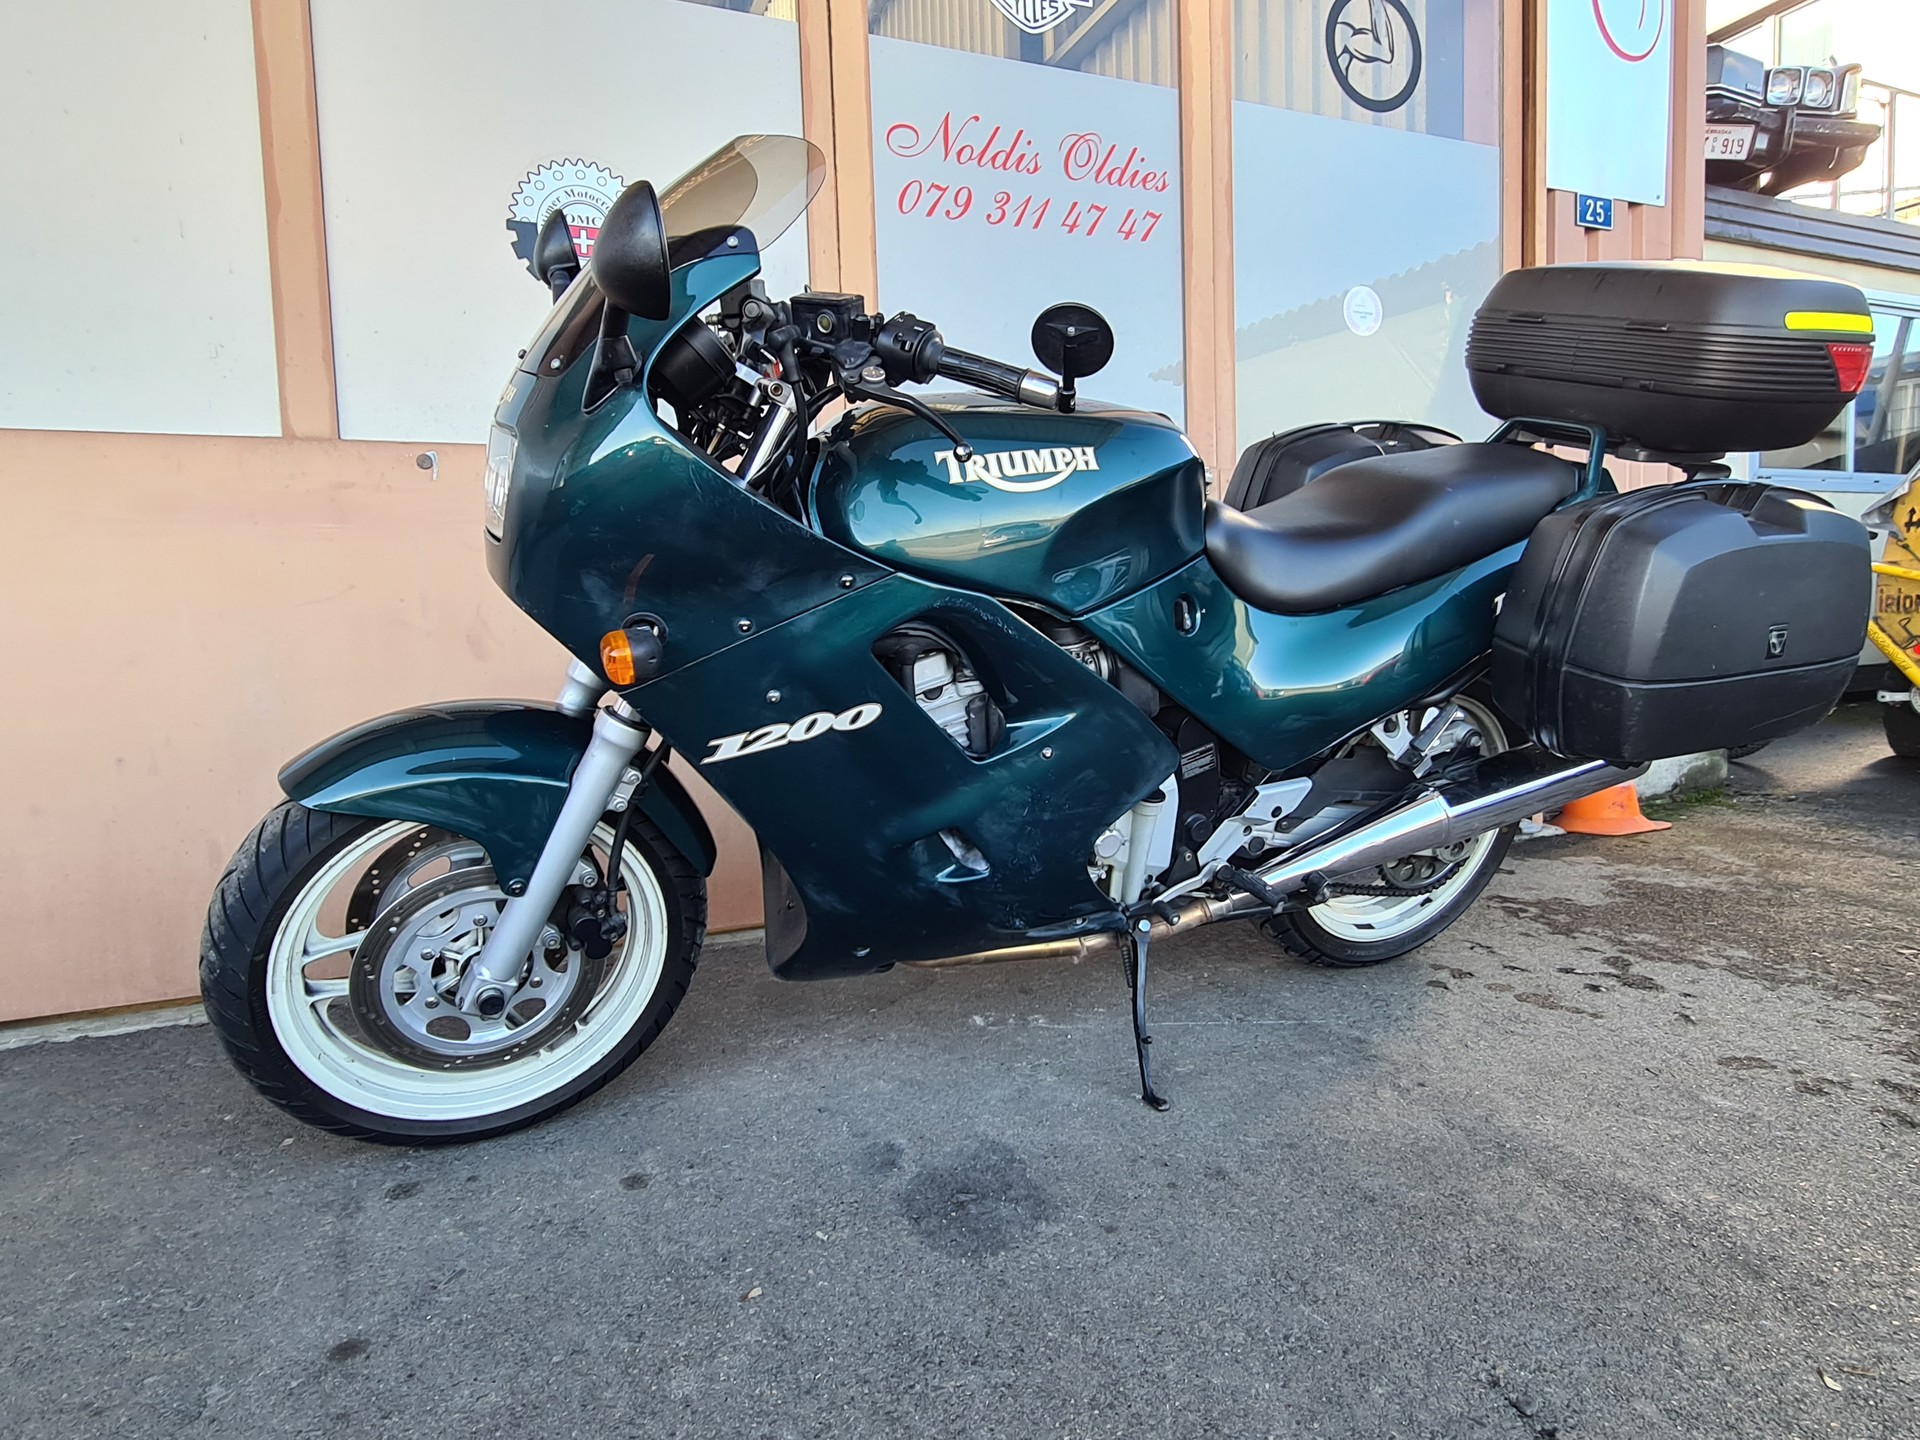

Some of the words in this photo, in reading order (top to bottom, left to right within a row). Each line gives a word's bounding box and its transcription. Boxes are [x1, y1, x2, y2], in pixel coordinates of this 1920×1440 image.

[886, 111, 1042, 175] Noldis
[1058, 132, 1170, 193] Oldies
[1720, 138, 1744, 155] 919
[897, 179, 974, 221] 079
[985, 190, 1051, 230] 311
[1060, 201, 1108, 237] 47
[1117, 208, 1163, 242] 47
[1585, 198, 1605, 223] 25
[933, 446, 1100, 493] TRIUMPH
[700, 702, 883, 766] 1200
